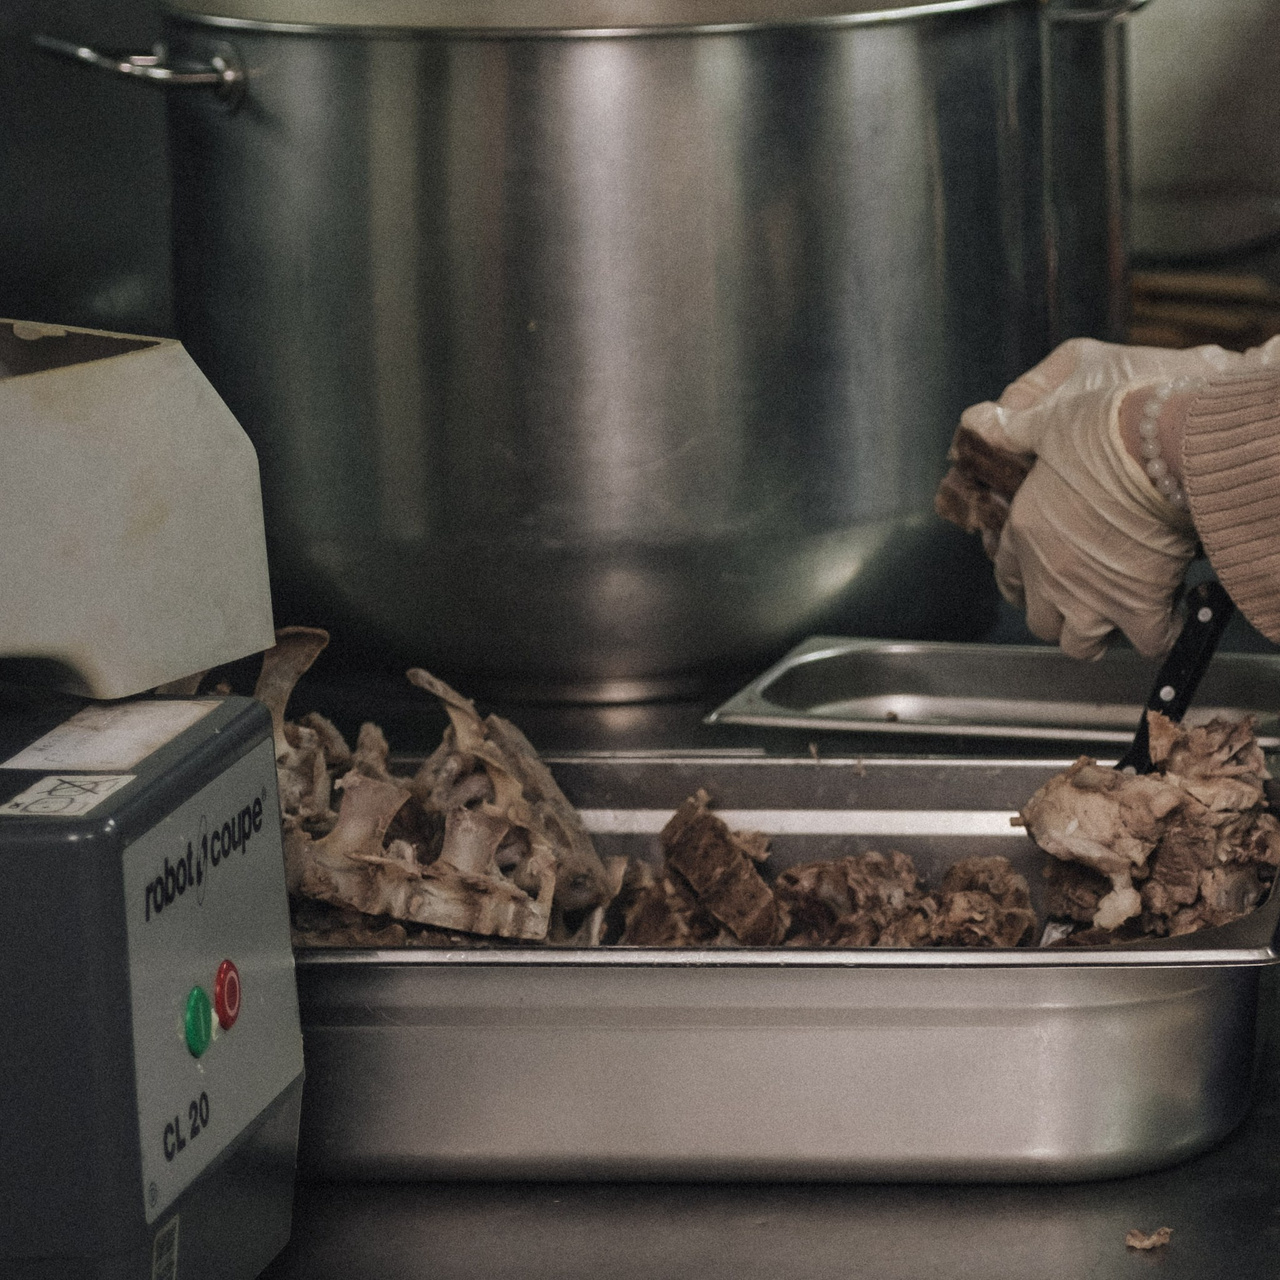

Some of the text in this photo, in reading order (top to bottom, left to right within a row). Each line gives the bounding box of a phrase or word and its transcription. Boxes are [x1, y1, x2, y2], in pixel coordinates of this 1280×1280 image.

[145, 841, 194, 922] robot
[163, 1091, 210, 1163] CL 20
